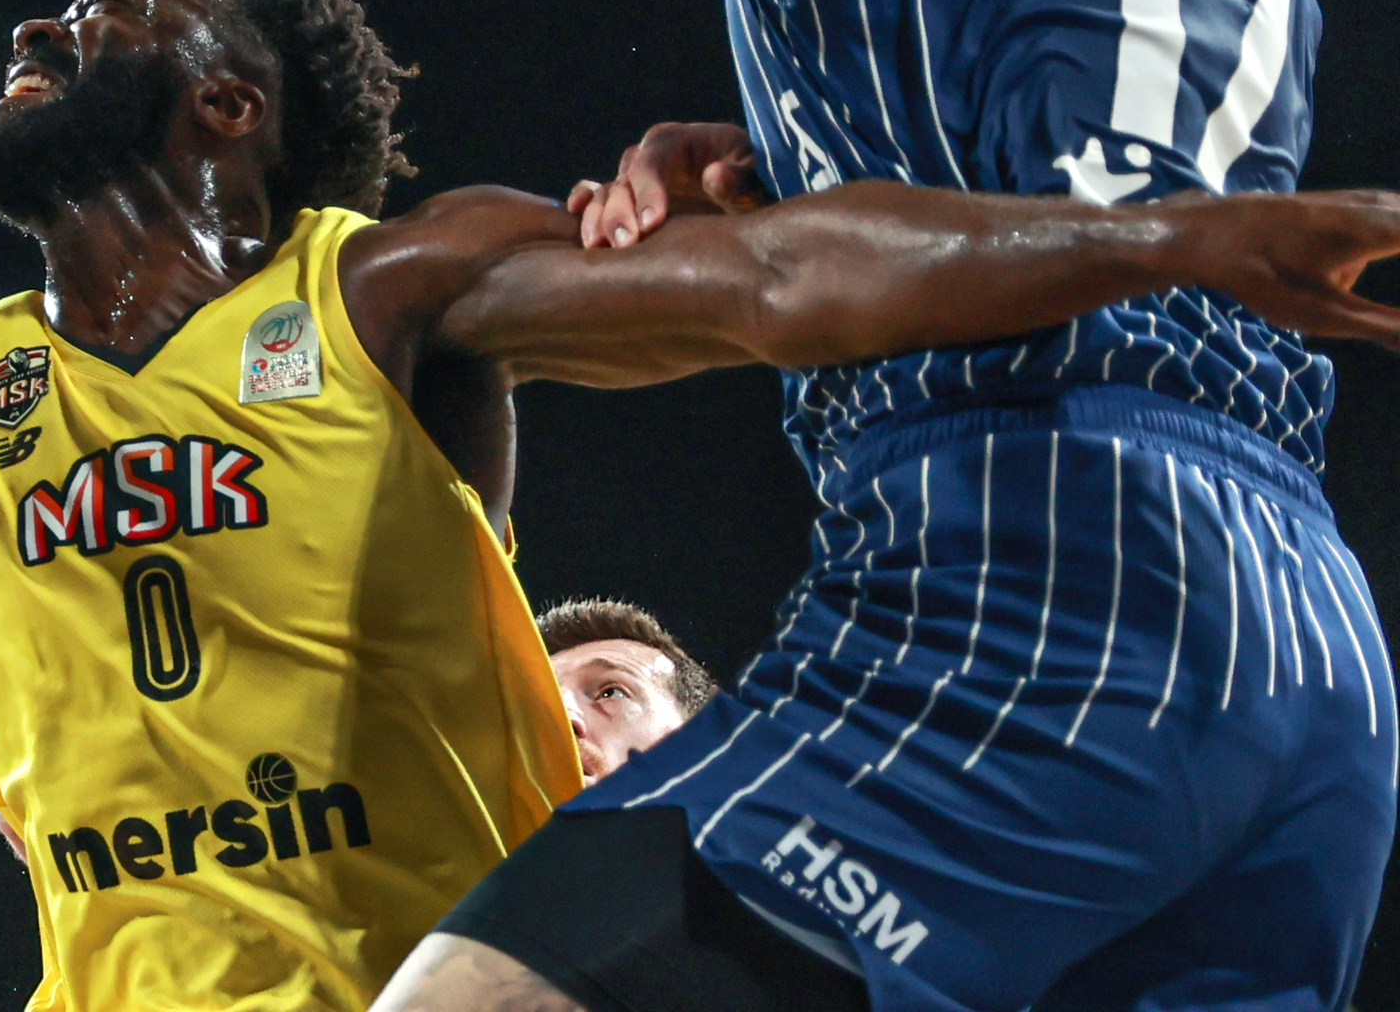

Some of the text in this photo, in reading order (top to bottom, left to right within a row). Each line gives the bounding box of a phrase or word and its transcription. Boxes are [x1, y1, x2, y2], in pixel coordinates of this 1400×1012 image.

[17, 433, 269, 568] MSK
[123, 554, 201, 702] 0
[47, 753, 371, 894] mersin
[775, 814, 929, 966] HSM
